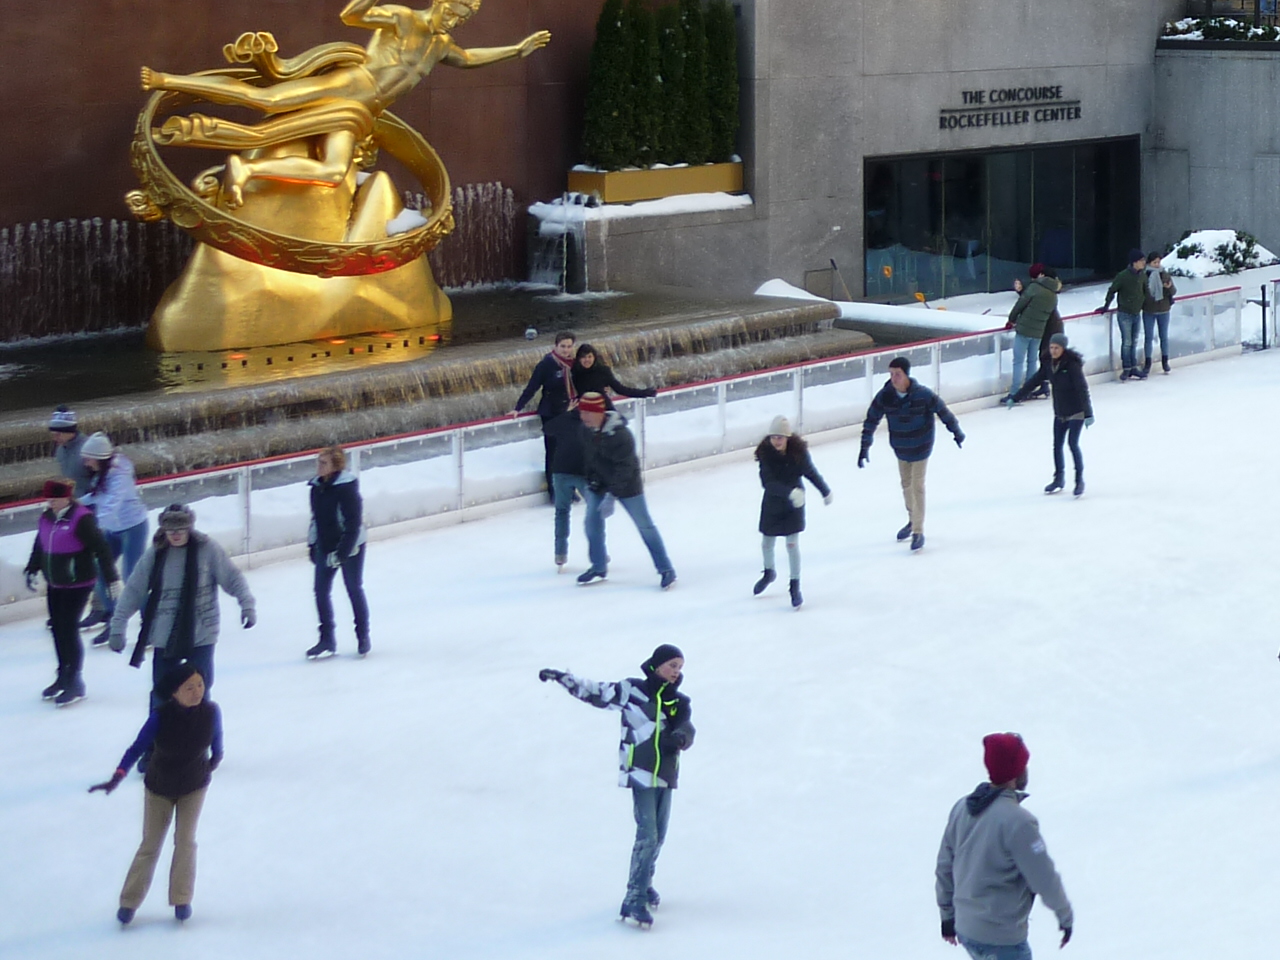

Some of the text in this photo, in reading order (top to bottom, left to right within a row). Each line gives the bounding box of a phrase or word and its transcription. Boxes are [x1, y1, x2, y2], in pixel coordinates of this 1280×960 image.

[962, 85, 1063, 104] THE CONCOURSE
[939, 106, 1081, 129] ROCKEFELLER CENTER
